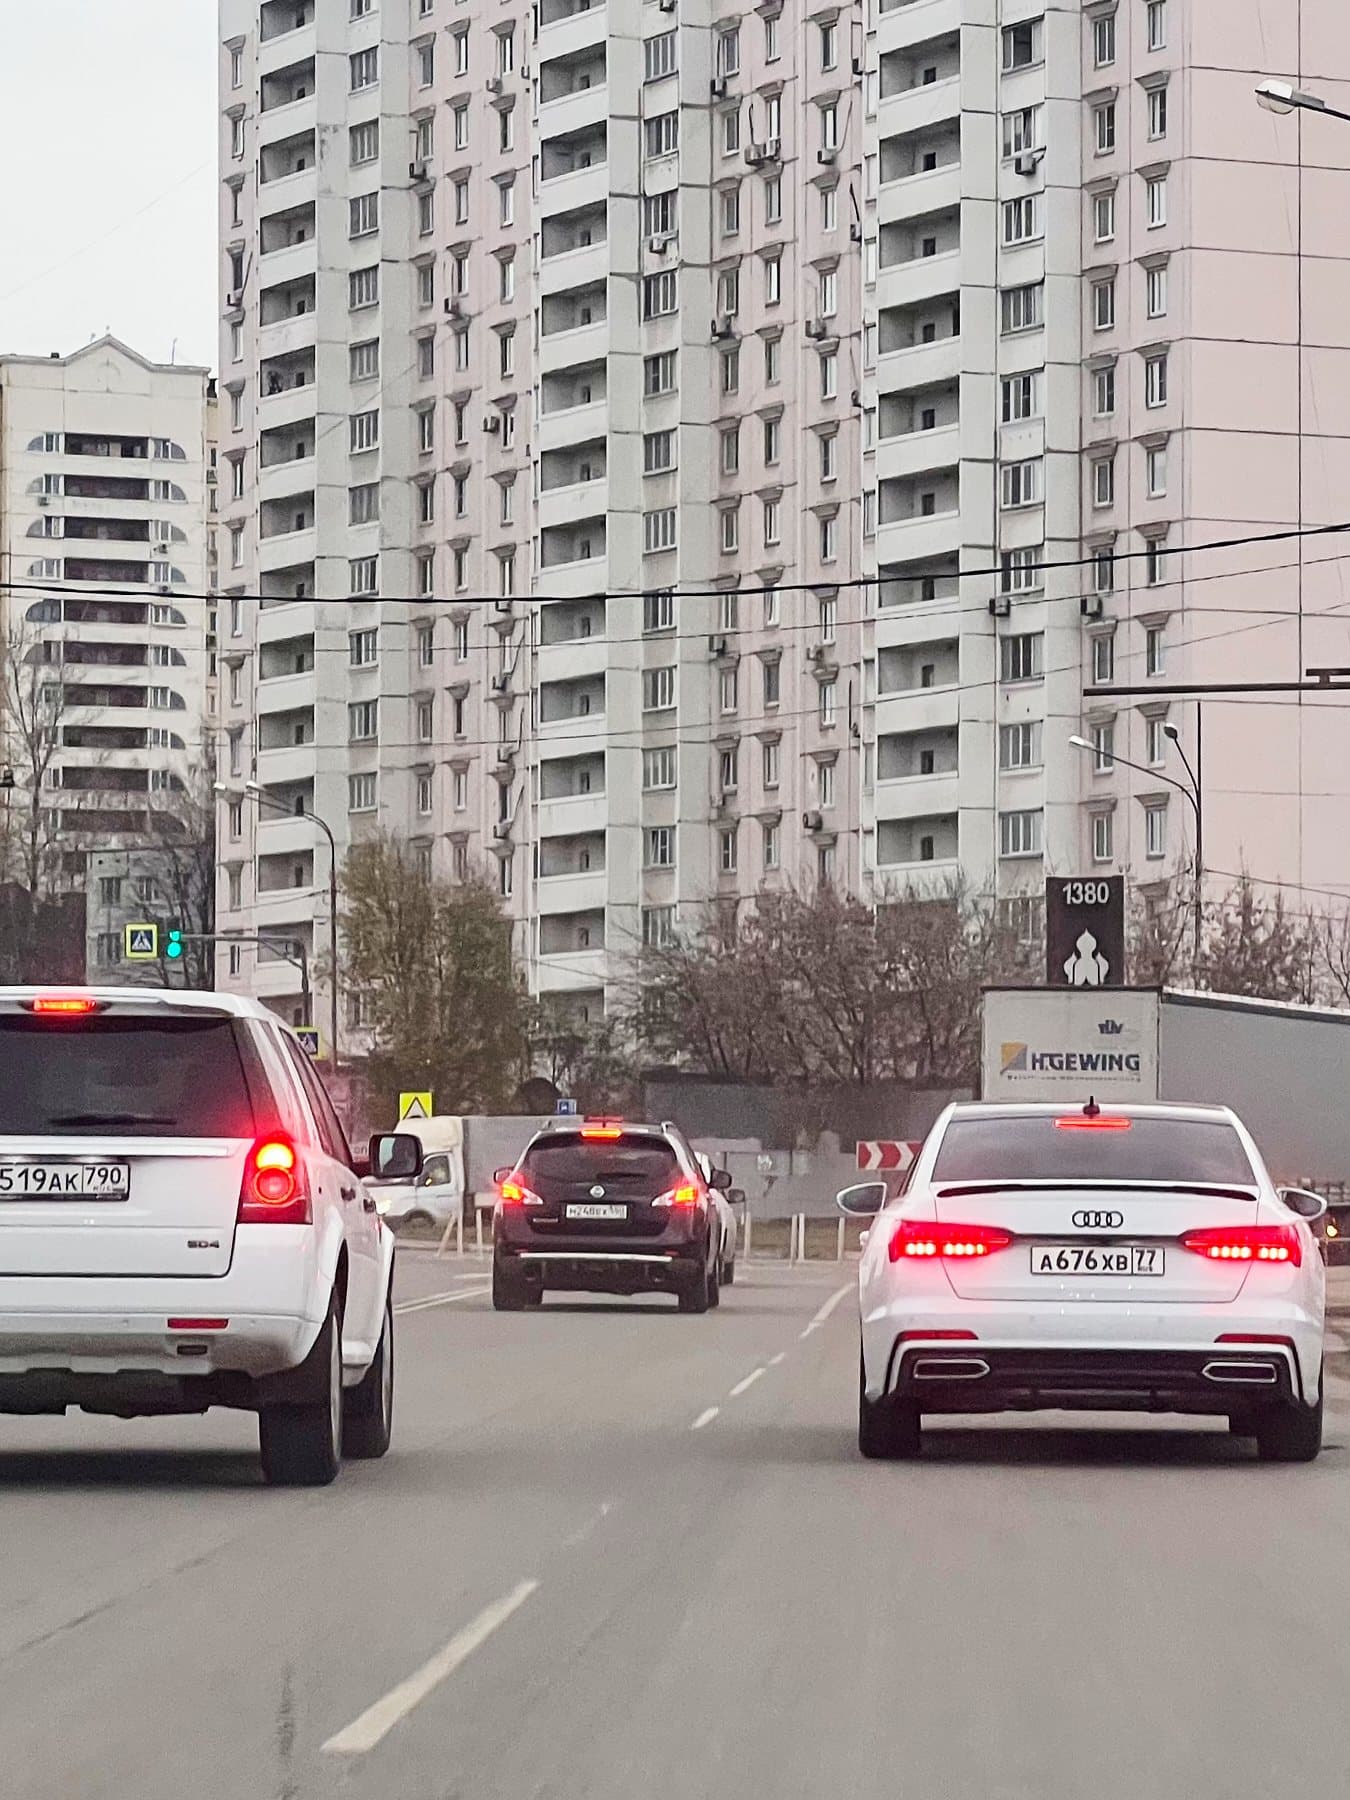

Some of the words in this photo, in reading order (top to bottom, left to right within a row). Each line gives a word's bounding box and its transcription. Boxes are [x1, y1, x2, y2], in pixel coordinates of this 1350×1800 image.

[1062, 882, 1110, 905] 1380
[85, 1166, 122, 1185] 790
[1135, 1249, 1157, 1266] 77
